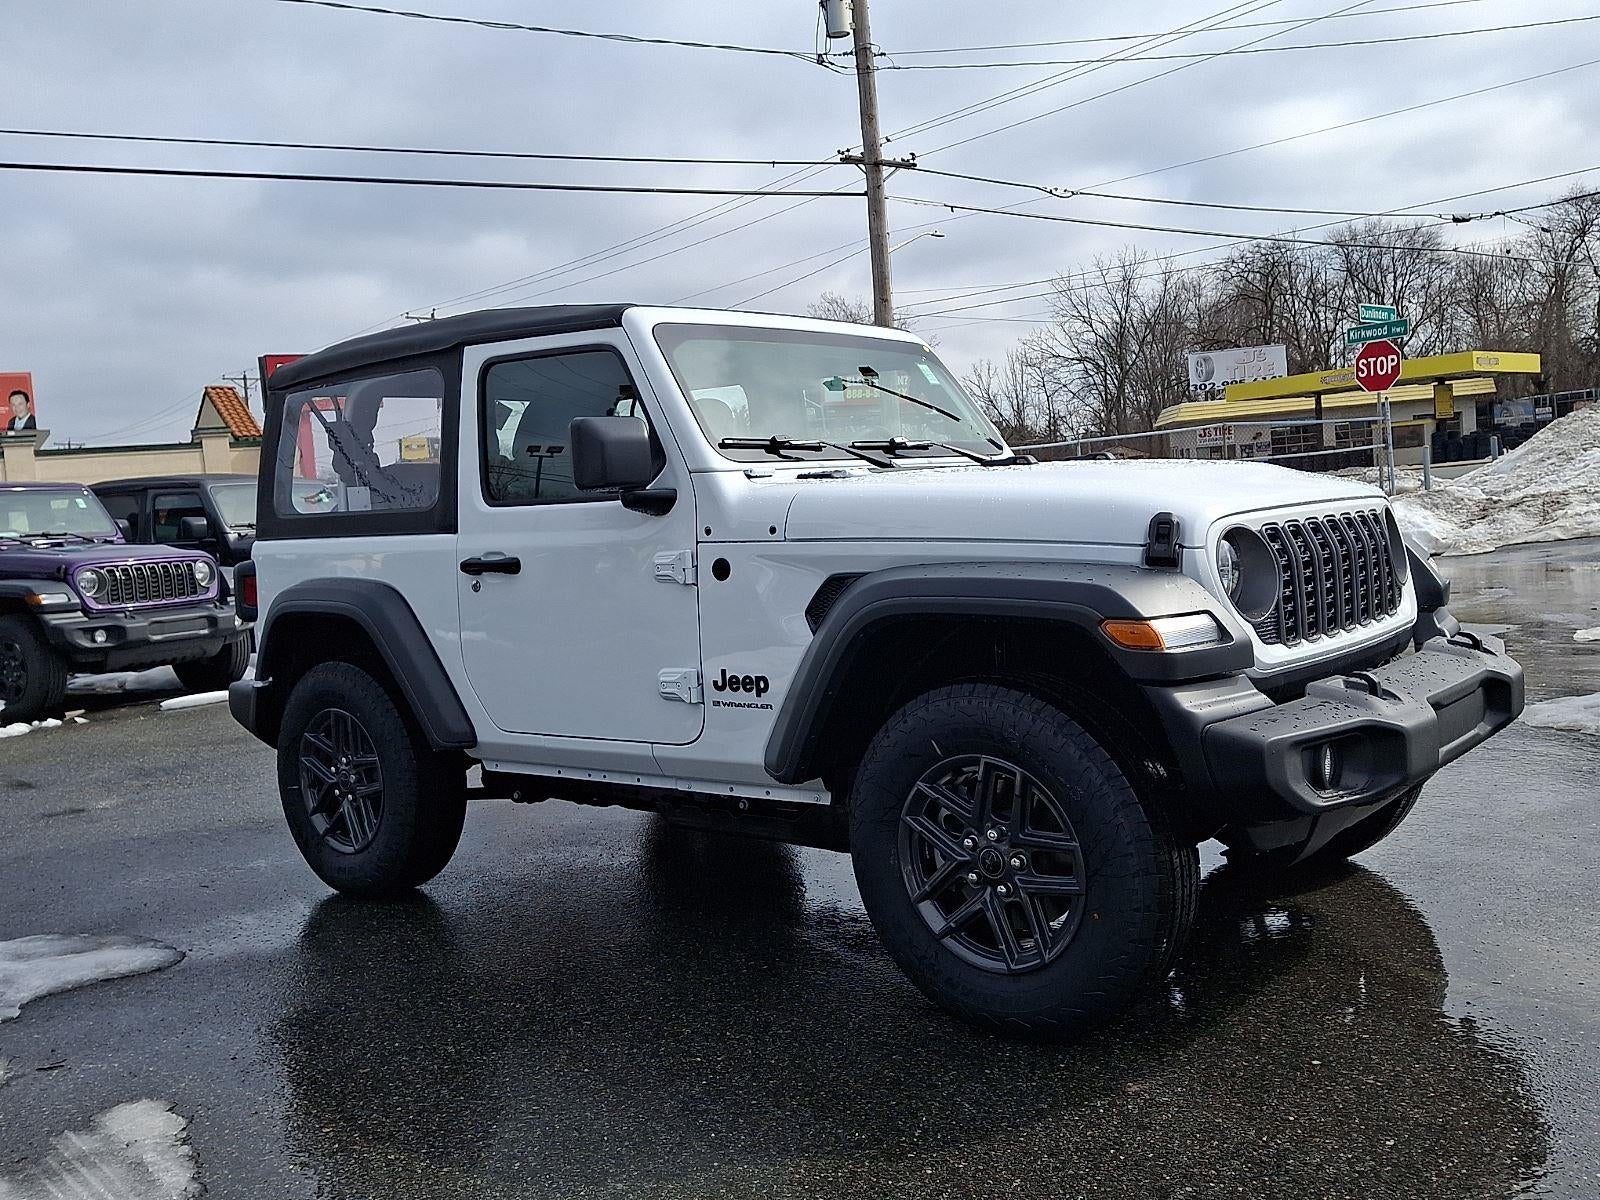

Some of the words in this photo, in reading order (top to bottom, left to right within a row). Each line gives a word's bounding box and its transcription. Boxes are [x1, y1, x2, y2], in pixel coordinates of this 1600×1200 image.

[1349, 325, 1388, 340] Kirkwood
[1226, 362, 1275, 380] TIRE
[1357, 354, 1398, 378] STOP
[712, 668, 770, 698] Jeep
[720, 700, 774, 711] WRANGLER
